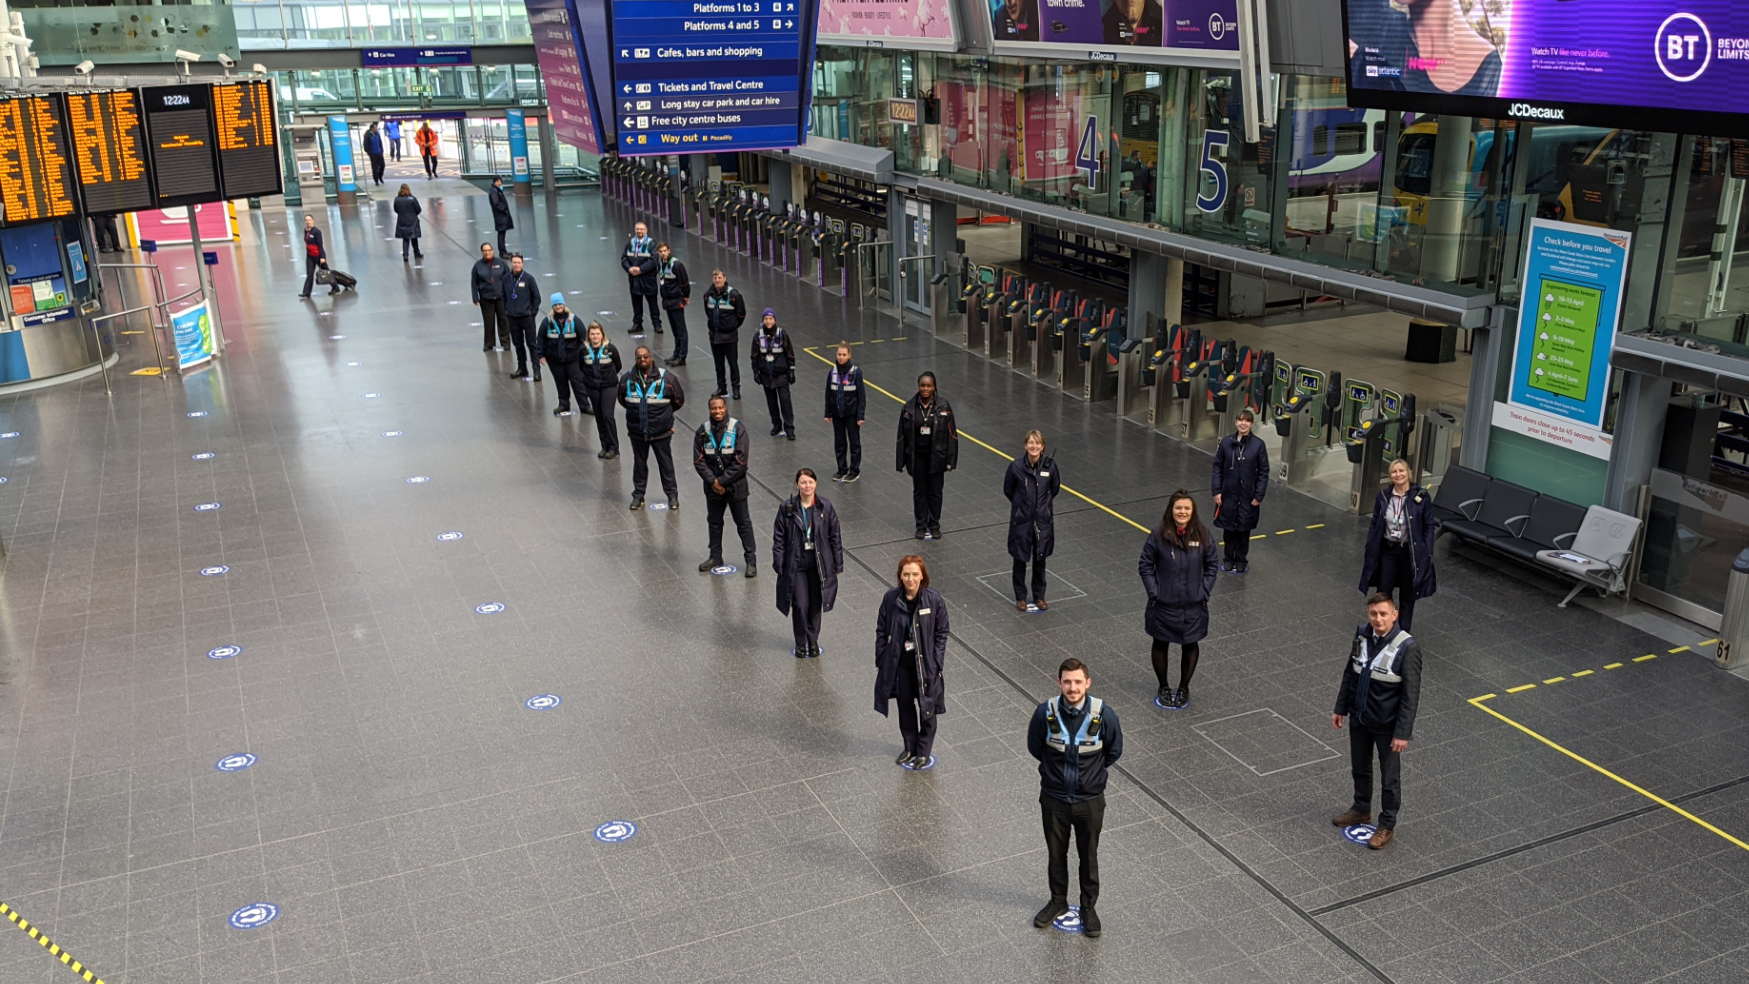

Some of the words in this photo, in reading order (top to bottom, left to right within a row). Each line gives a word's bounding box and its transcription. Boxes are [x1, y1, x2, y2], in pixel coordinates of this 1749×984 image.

[693, 3, 735, 13] Platforms
[736, 3, 741, 12] 1
[742, 3, 752, 12] to
[753, 3, 760, 12] 3
[684, 21, 727, 31] Platforms
[727, 21, 734, 30] 4
[735, 20, 751, 30] and
[753, 20, 760, 30] 5
[1212, 21, 1221, 31] BT
[657, 47, 685, 59] Cafes,
[686, 47, 705, 57] bars
[706, 47, 723, 57] and
[724, 46, 763, 57] shopping
[1531, 47, 1549, 55] Watch
[1549, 47, 1559, 55] TV
[1559, 48, 1570, 56] like
[1570, 49, 1588, 57] never
[1587, 49, 1610, 57] before.
[1667, 35, 1699, 60] BT
[1090, 51, 1115, 61] JCDecaux
[1408, 57, 1438, 70] NOW
[1378, 66, 1400, 76] atlantic
[658, 82, 689, 93] Tickets
[690, 81, 707, 91] and
[708, 81, 734, 91] Travel
[735, 81, 764, 90] Centre
[661, 100, 682, 110] Long
[683, 100, 700, 109] stay
[702, 100, 714, 108] car
[716, 98, 734, 108] park
[735, 97, 750, 106] and
[751, 98, 764, 106] car
[765, 97, 780, 105] hire
[1508, 103, 1564, 119] JCDecaux
[651, 116, 671, 126] Free
[671, 116, 687, 127] city
[689, 115, 716, 125] centre
[717, 113, 741, 124] buses
[660, 134, 681, 145] Way
[682, 133, 698, 143] out
[710, 134, 733, 142] Piccadilly
[1075, 115, 1100, 190] 4
[1196, 129, 1230, 213] 5
[1544, 236, 1561, 246] Check
[1562, 238, 1581, 249] before
[1581, 243, 1593, 252] you
[1594, 244, 1612, 254] travel
[24, 314, 46, 323] Customer
[46, 309, 69, 318] Information
[1510, 411, 1523, 421] Train
[1523, 415, 1537, 425] doors
[1537, 418, 1550, 429] close
[1551, 424, 1559, 432] up
[1566, 427, 1573, 436] 45
[1573, 431, 1595, 442] seconds
[1527, 426, 1540, 436] prior
[1540, 428, 1547, 436] to
[1547, 429, 1573, 444] departure
[1717, 639, 1730, 662] 61
